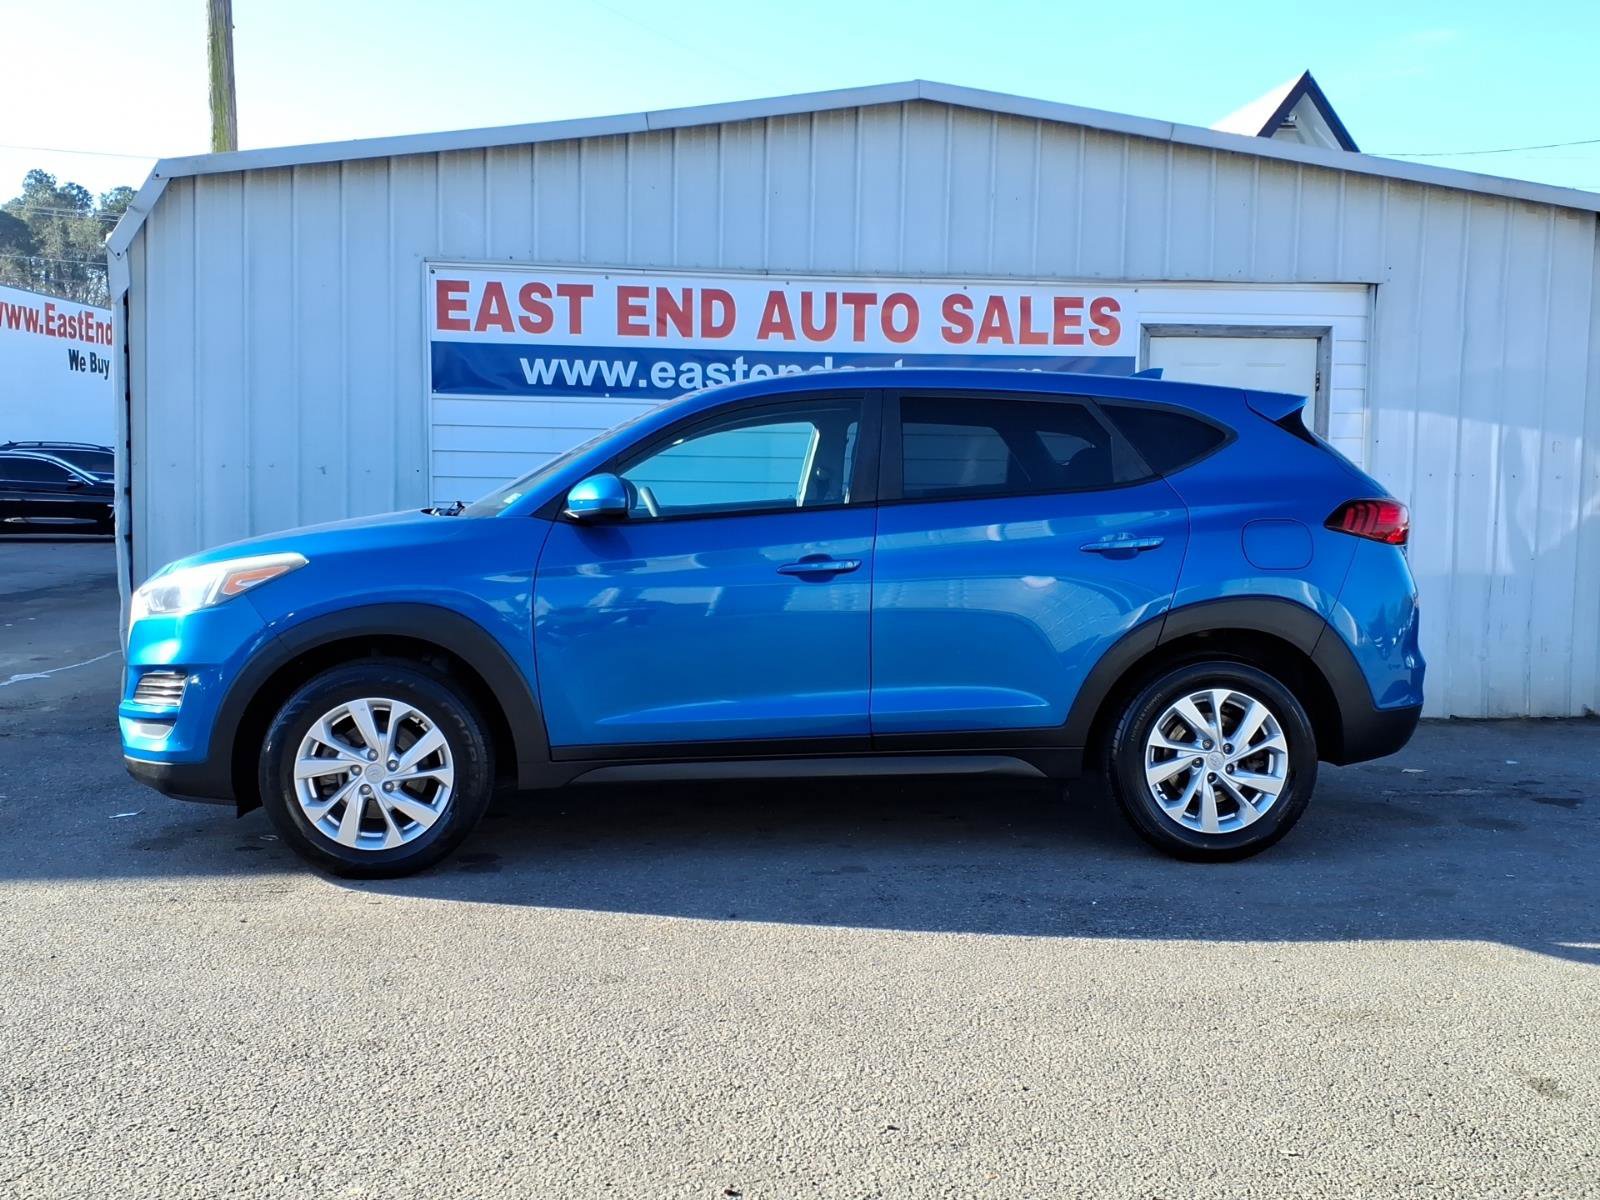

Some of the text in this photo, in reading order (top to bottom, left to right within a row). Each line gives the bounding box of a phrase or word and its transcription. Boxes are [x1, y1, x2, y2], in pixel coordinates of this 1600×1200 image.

[0, 302, 112, 346] ww.EastEnd
[436, 279, 1122, 347] EAST END AUTO SALES
[68, 348, 110, 380] We Buy
